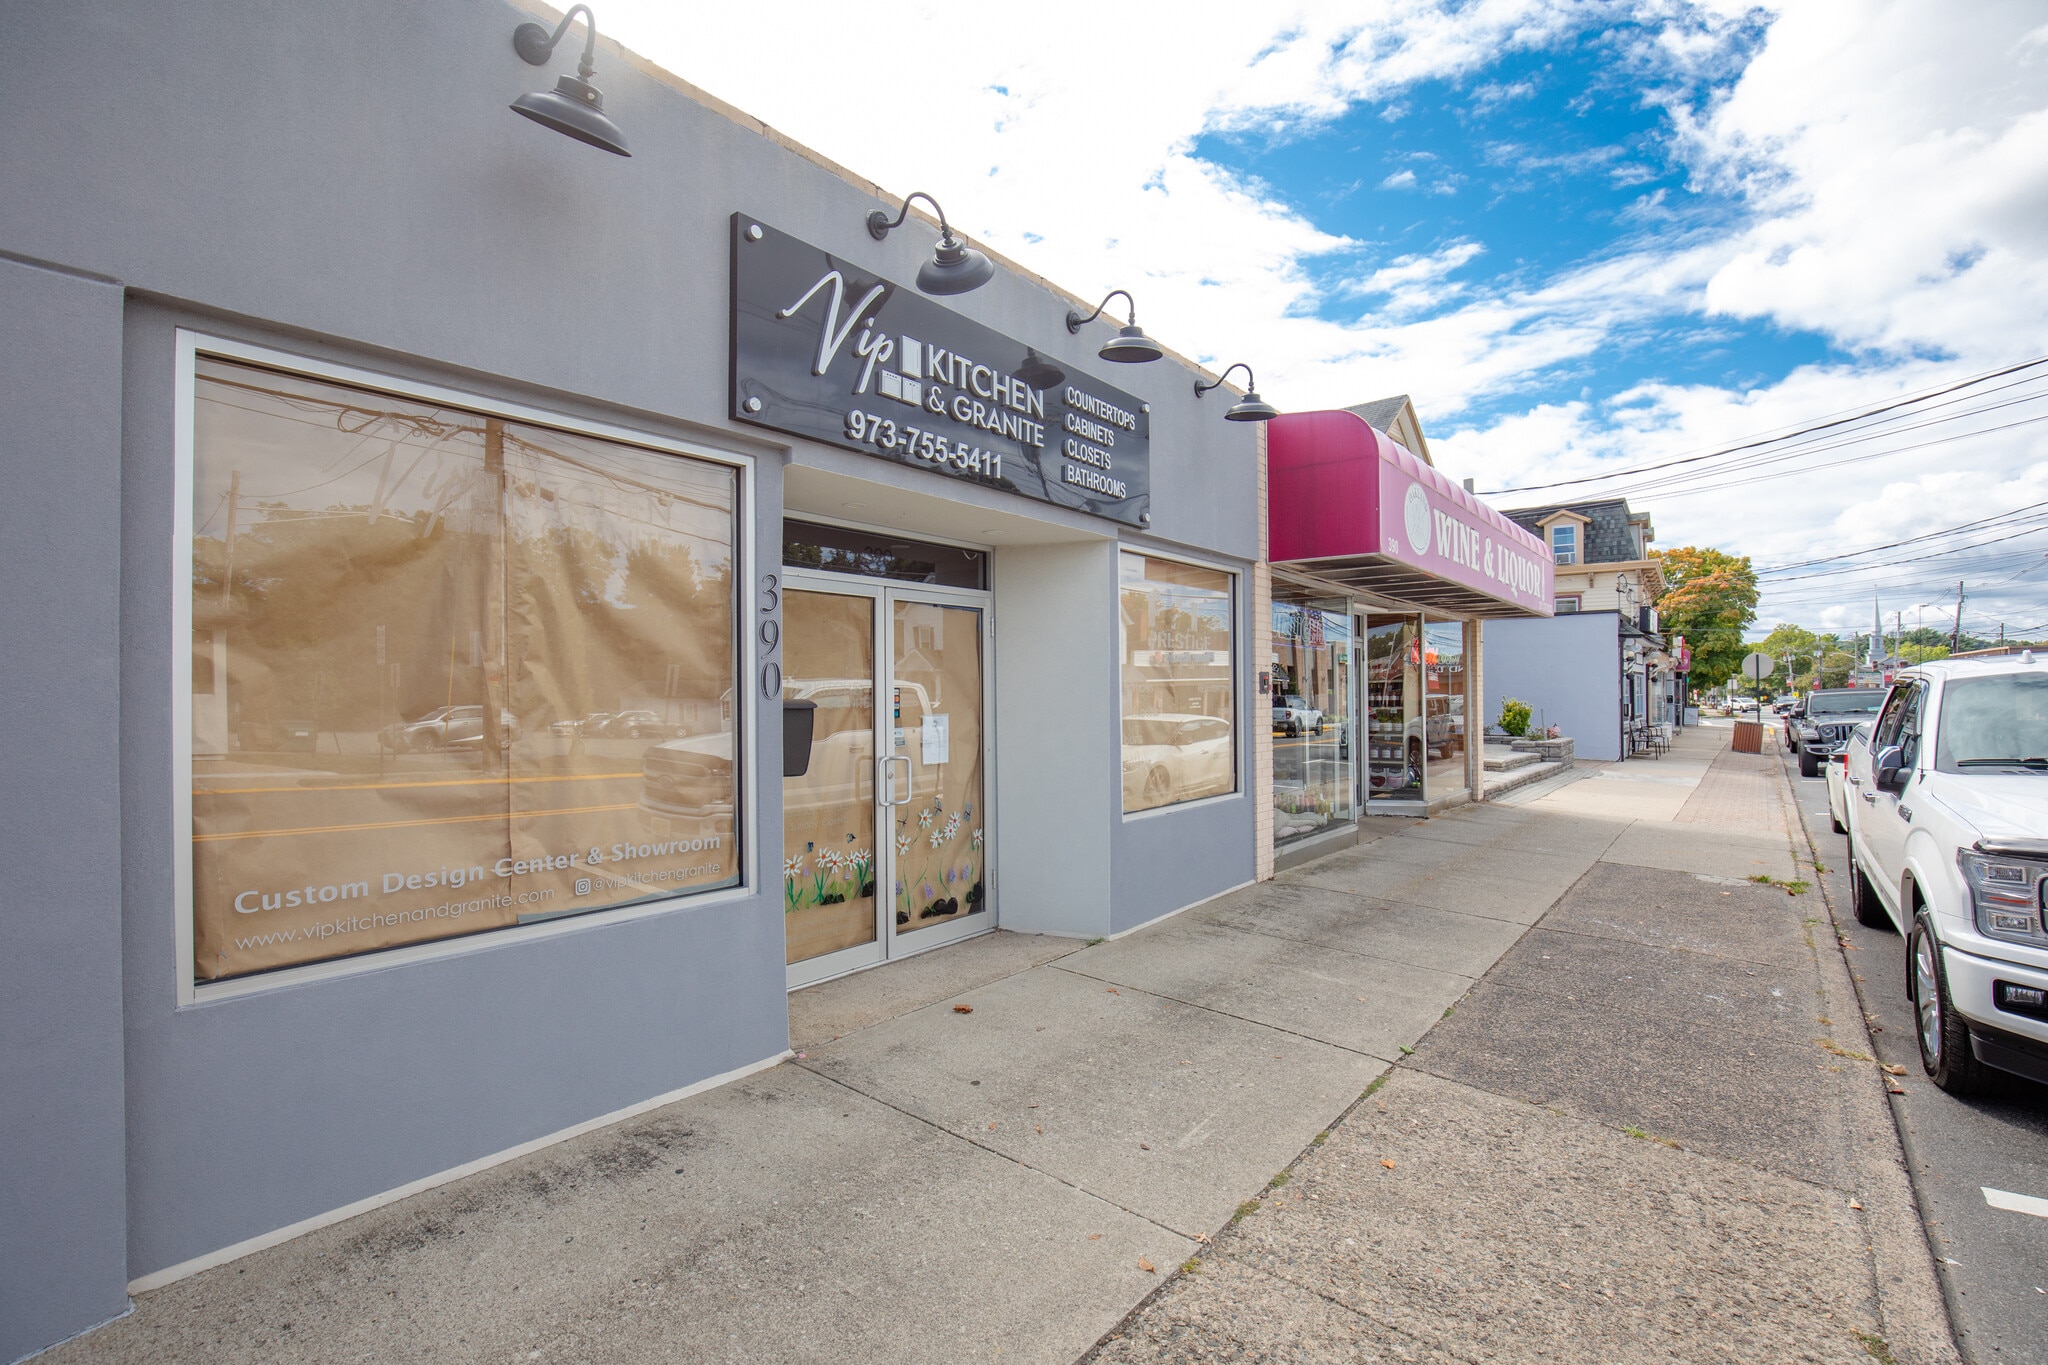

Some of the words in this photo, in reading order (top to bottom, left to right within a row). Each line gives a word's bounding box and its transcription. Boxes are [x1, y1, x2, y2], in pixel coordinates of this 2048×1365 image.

[777, 270, 894, 394] Vip
[927, 343, 1044, 418] KITCHEN
[1064, 386, 1136, 430] COUNTERTOPS
[846, 410, 1001, 479] 973-755-5411
[925, 386, 947, 415] &
[951, 396, 1044, 447] GRANITE
[1064, 413, 1115, 447] CABINETS
[1063, 465, 1126, 499] BATHROOMS
[1064, 439, 1111, 470] CLOSETS
[1433, 508, 1480, 572] WINE
[1484, 536, 1495, 578] &
[1497, 544, 1541, 599] LIQUOR
[759, 573, 781, 701] 390
[234, 878, 369, 914] Custom
[382, 862, 485, 894] Design
[494, 849, 578, 877] Center
[587, 847, 602, 864] &
[611, 833, 721, 861] Showroom
[593, 862, 721, 892] @vipkitchengranite
[235, 886, 555, 950] www.vipkitchenandgranite.com
